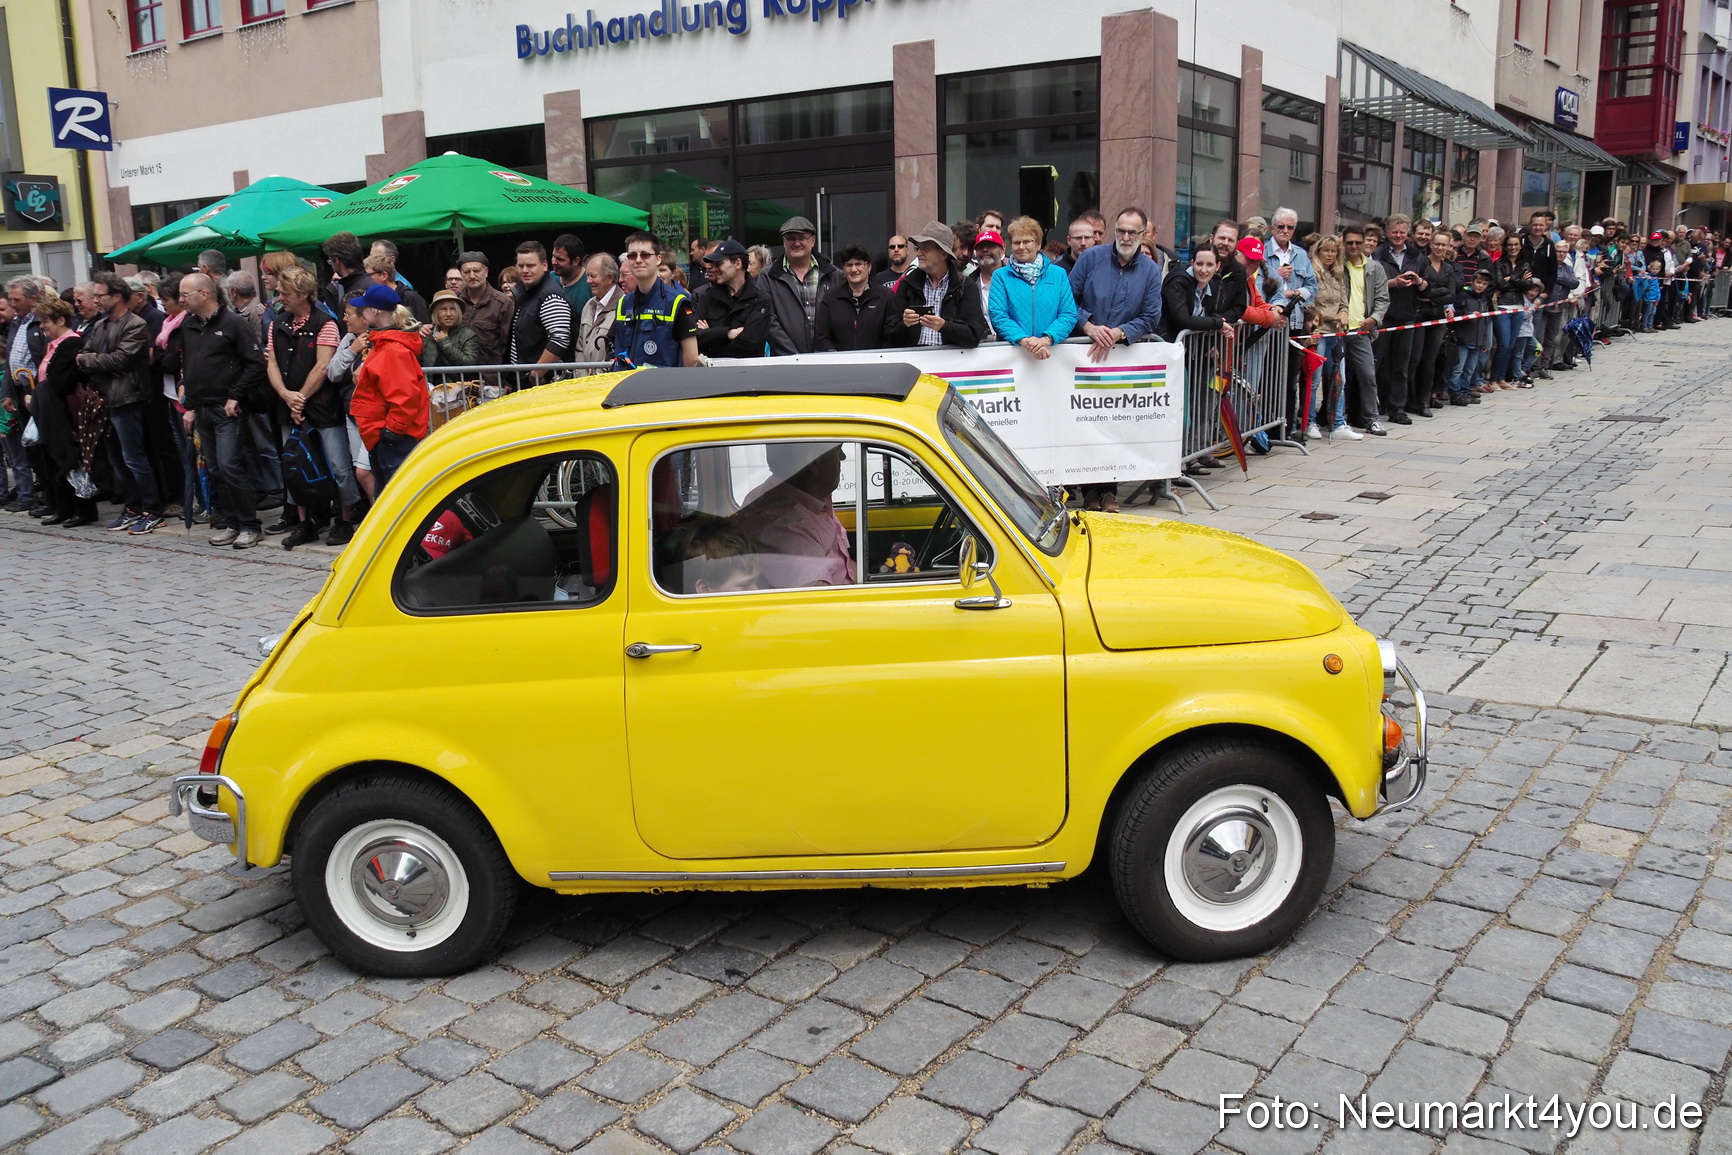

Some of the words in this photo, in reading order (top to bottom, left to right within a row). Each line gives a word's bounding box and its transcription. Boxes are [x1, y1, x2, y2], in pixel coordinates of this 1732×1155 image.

[515, 0, 749, 59] Buchhandlung
[763, 0, 872, 22] Rupp
[120, 168, 139, 179] Unterer
[139, 164, 155, 176] Markt
[155, 162, 163, 174] 15
[27, 190, 47, 213] G2
[501, 193, 590, 205] Lammsbräu
[322, 201, 408, 220] Lammsbräu
[968, 396, 1022, 414] Markt
[1070, 391, 1171, 410] NeuerMarkt
[1075, 414, 1108, 423] einkaufen
[1111, 413, 1132, 421] leben
[1135, 412, 1166, 422] genießen
[1032, 468, 1055, 476] eumarkt
[1064, 463, 1137, 474] www.neuermarkt-nm.de
[893, 477, 911, 487] 0-20
[423, 533, 452, 548] EKRA
